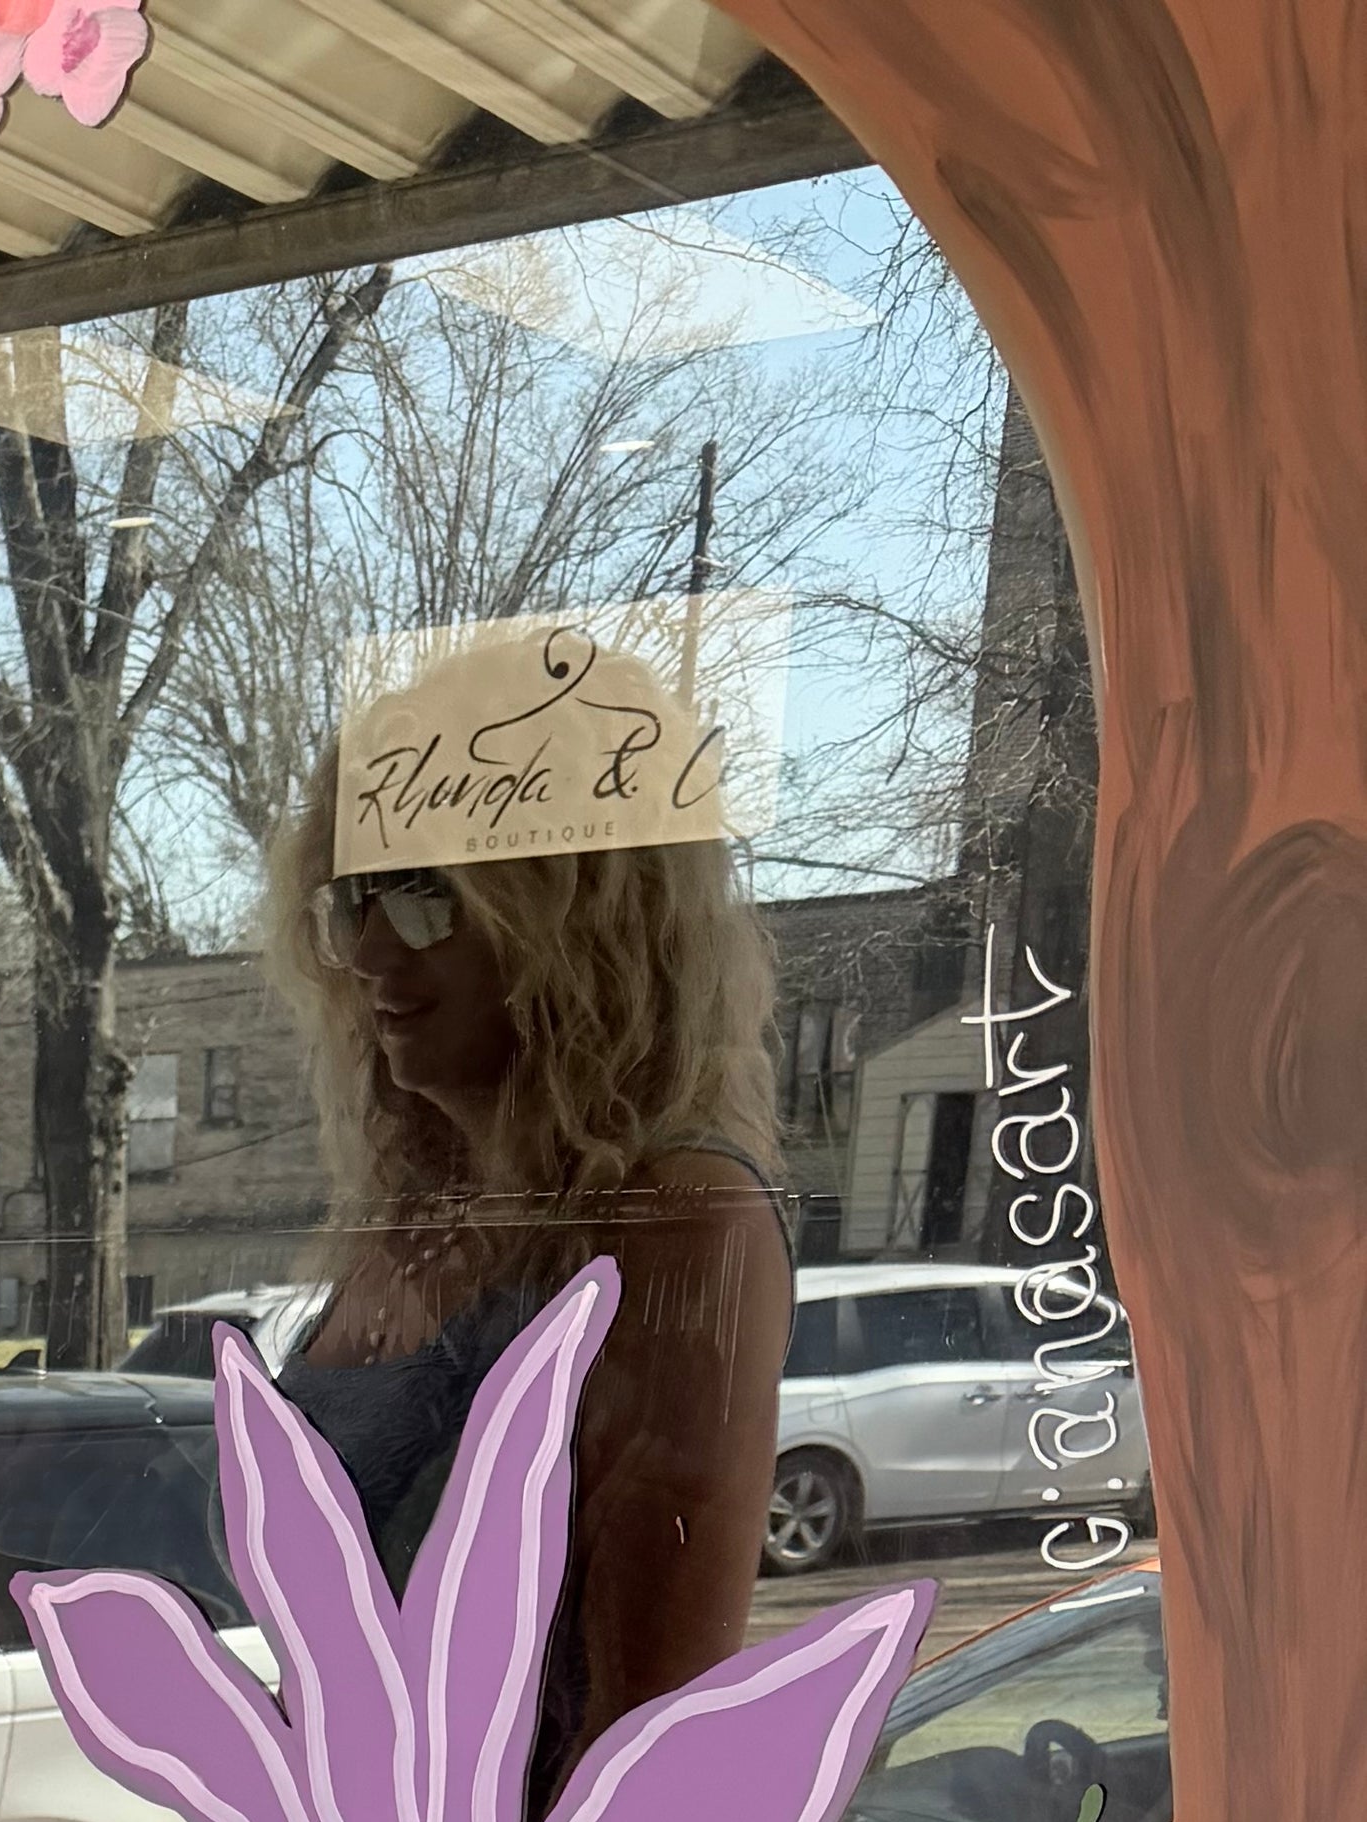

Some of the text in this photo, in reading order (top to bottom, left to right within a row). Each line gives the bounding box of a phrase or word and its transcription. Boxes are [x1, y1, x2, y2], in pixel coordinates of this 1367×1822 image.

[358, 725, 727, 849] Rhonda & C
[466, 821, 616, 853] BOUTIQUE
